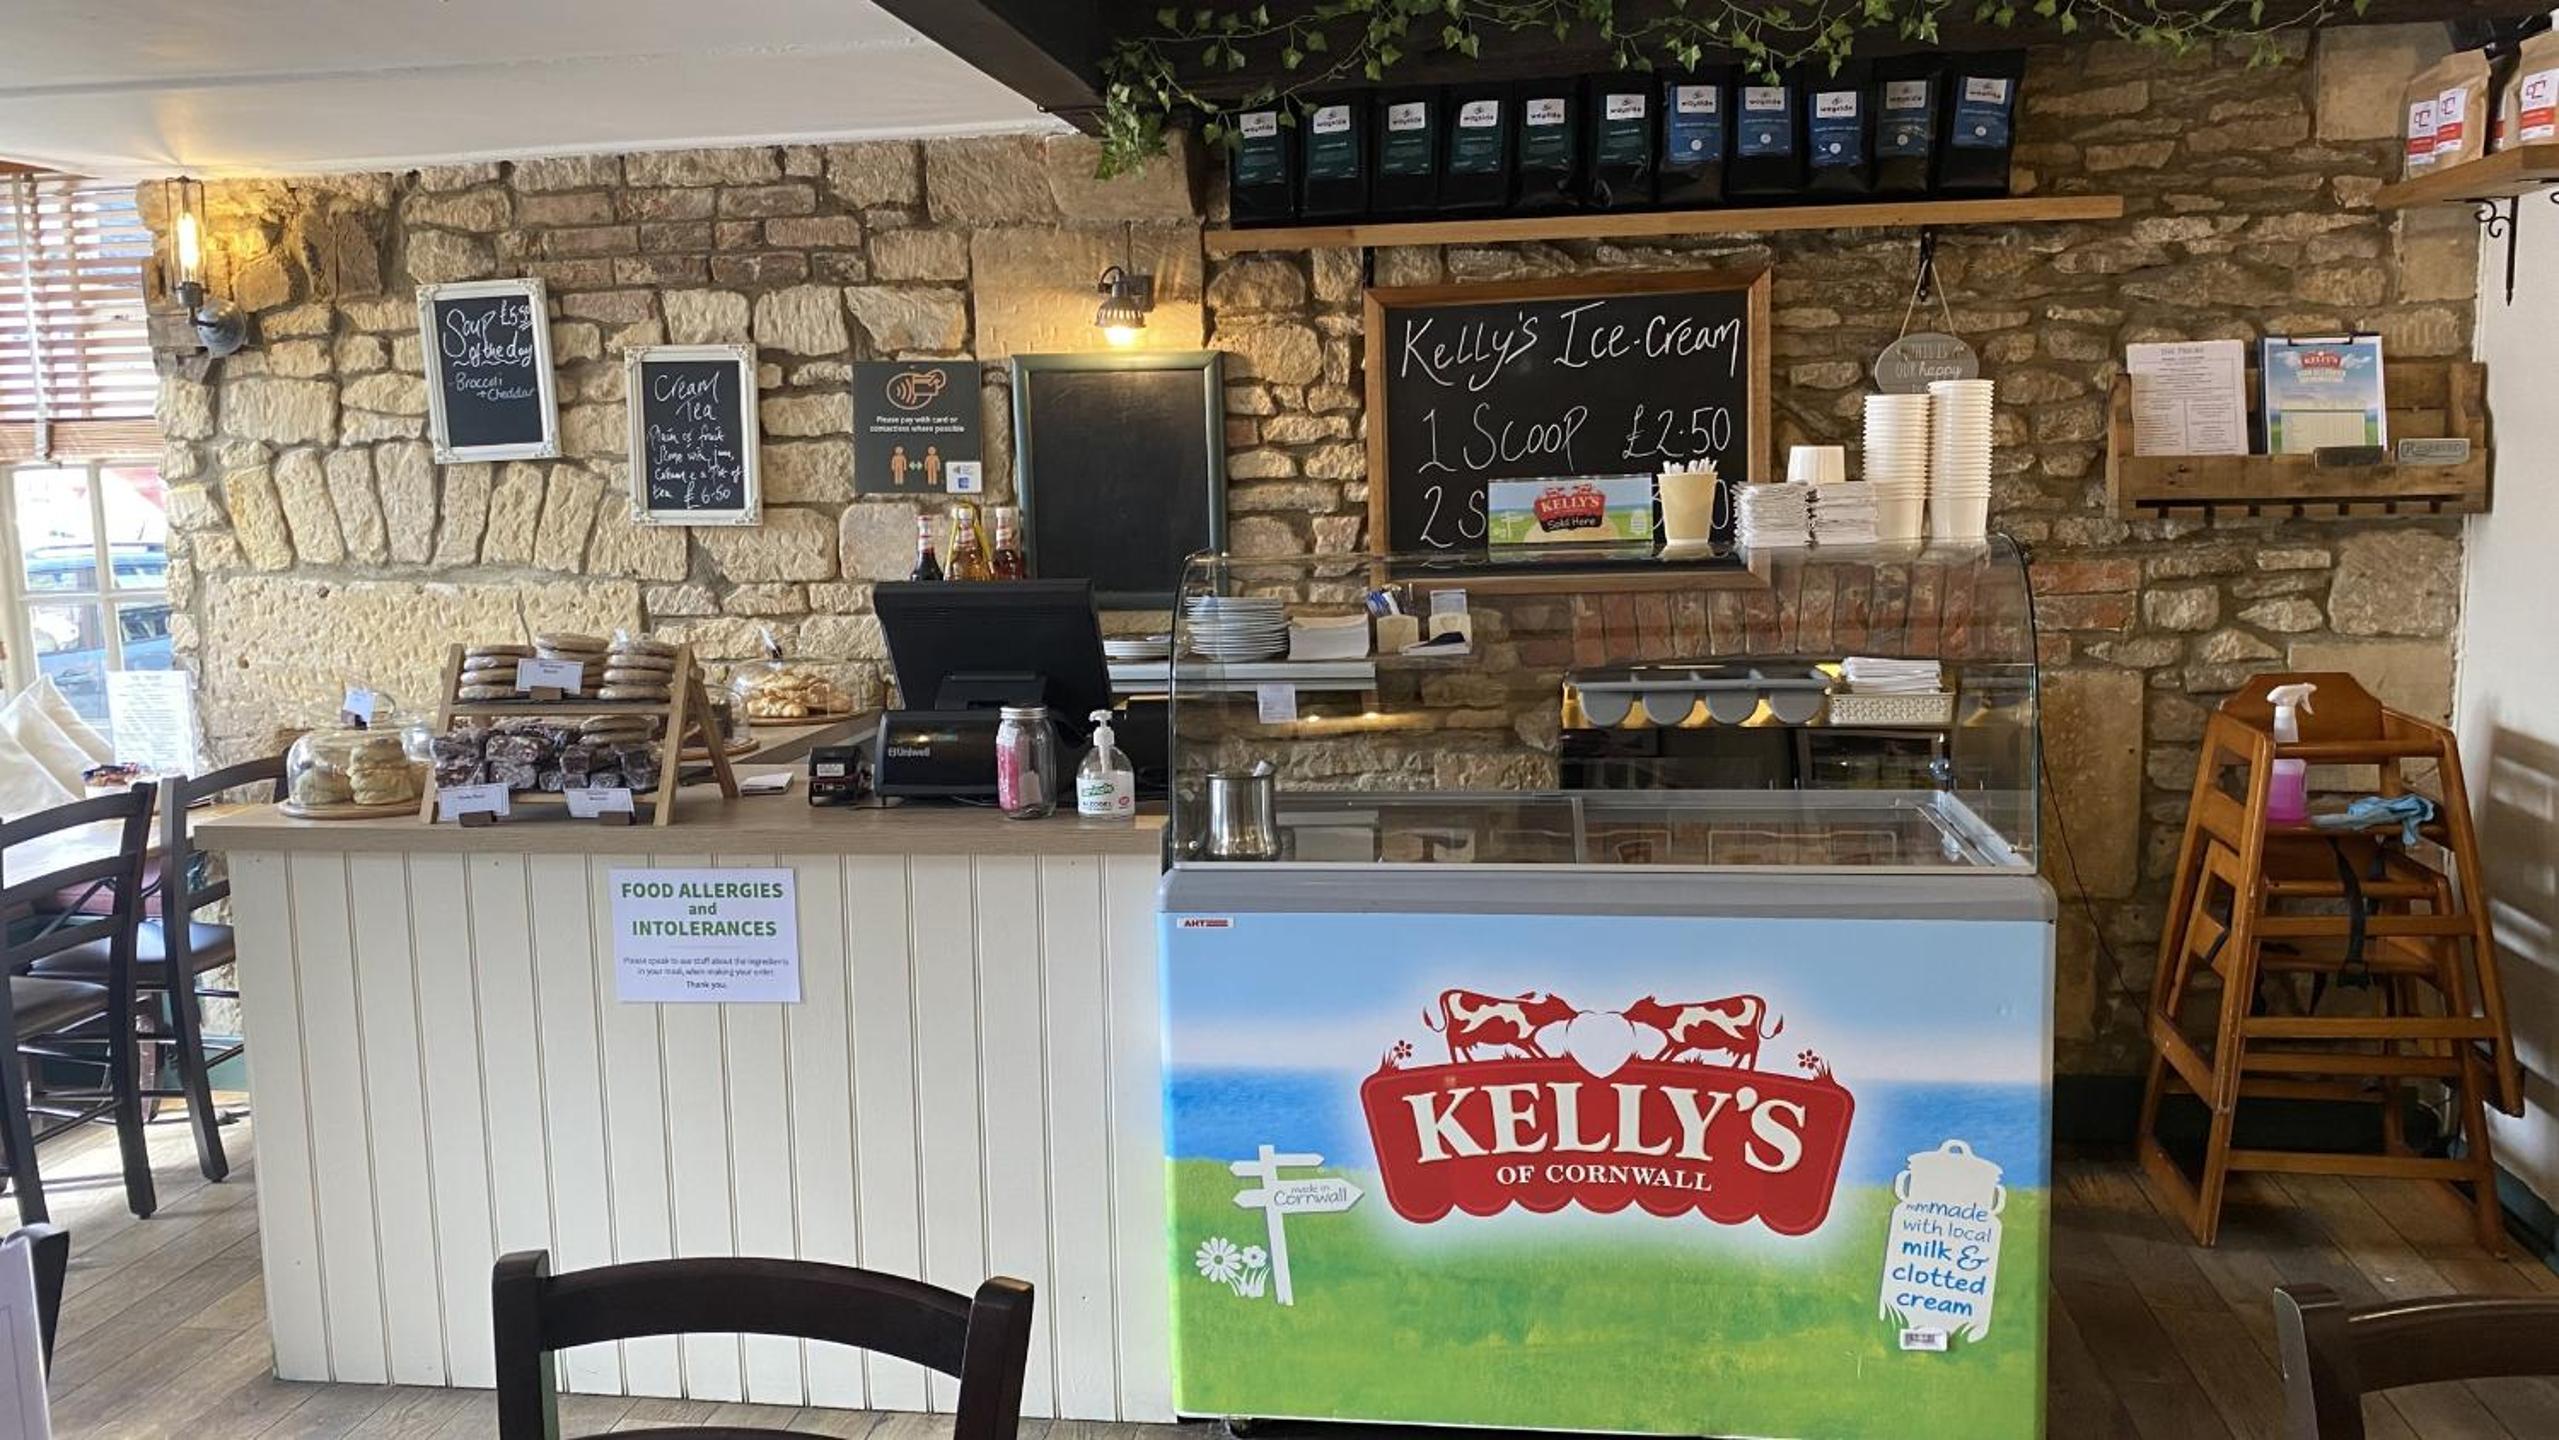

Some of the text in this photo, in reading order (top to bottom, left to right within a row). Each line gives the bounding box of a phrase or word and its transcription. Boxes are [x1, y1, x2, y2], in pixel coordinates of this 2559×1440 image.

[506, 330, 533, 368] day
[1401, 311, 1538, 392] Kelly's
[1918, 361, 1962, 380] happy
[455, 371, 503, 392] Broccoli
[675, 394, 717, 422] Tea
[900, 417, 913, 426] pay
[932, 416, 949, 424] card
[934, 426, 965, 434] possible
[1418, 408, 1457, 474] 1
[1622, 403, 1731, 460] £2.50
[1541, 495, 1600, 513] KELLY'S
[1420, 485, 1455, 548] 2
[1572, 517, 1597, 527] Here
[621, 882, 784, 898] FOOD ALLERGIES
[688, 902, 718, 916] and
[632, 920, 777, 936] INTOLERANCES
[623, 957, 647, 965] Please
[648, 957, 669, 966] speak
[693, 957, 710, 965] staff
[711, 957, 733, 965] about
[734, 957, 746, 965] the
[646, 969, 662, 977] your
[707, 968, 734, 978] making
[735, 969, 753, 977] your
[686, 980, 709, 989] Thank
[1403, 1081, 1805, 1174] KELLY'S
[1496, 1163, 1712, 1192] OF CORNWALL
[1273, 1187, 1347, 1206] Cornwall
[1903, 1219, 1992, 1243] with local
[1902, 1239, 1989, 1271] milk &
[1892, 1263, 1986, 1295] clotted
[1896, 1292, 1972, 1316] cream
